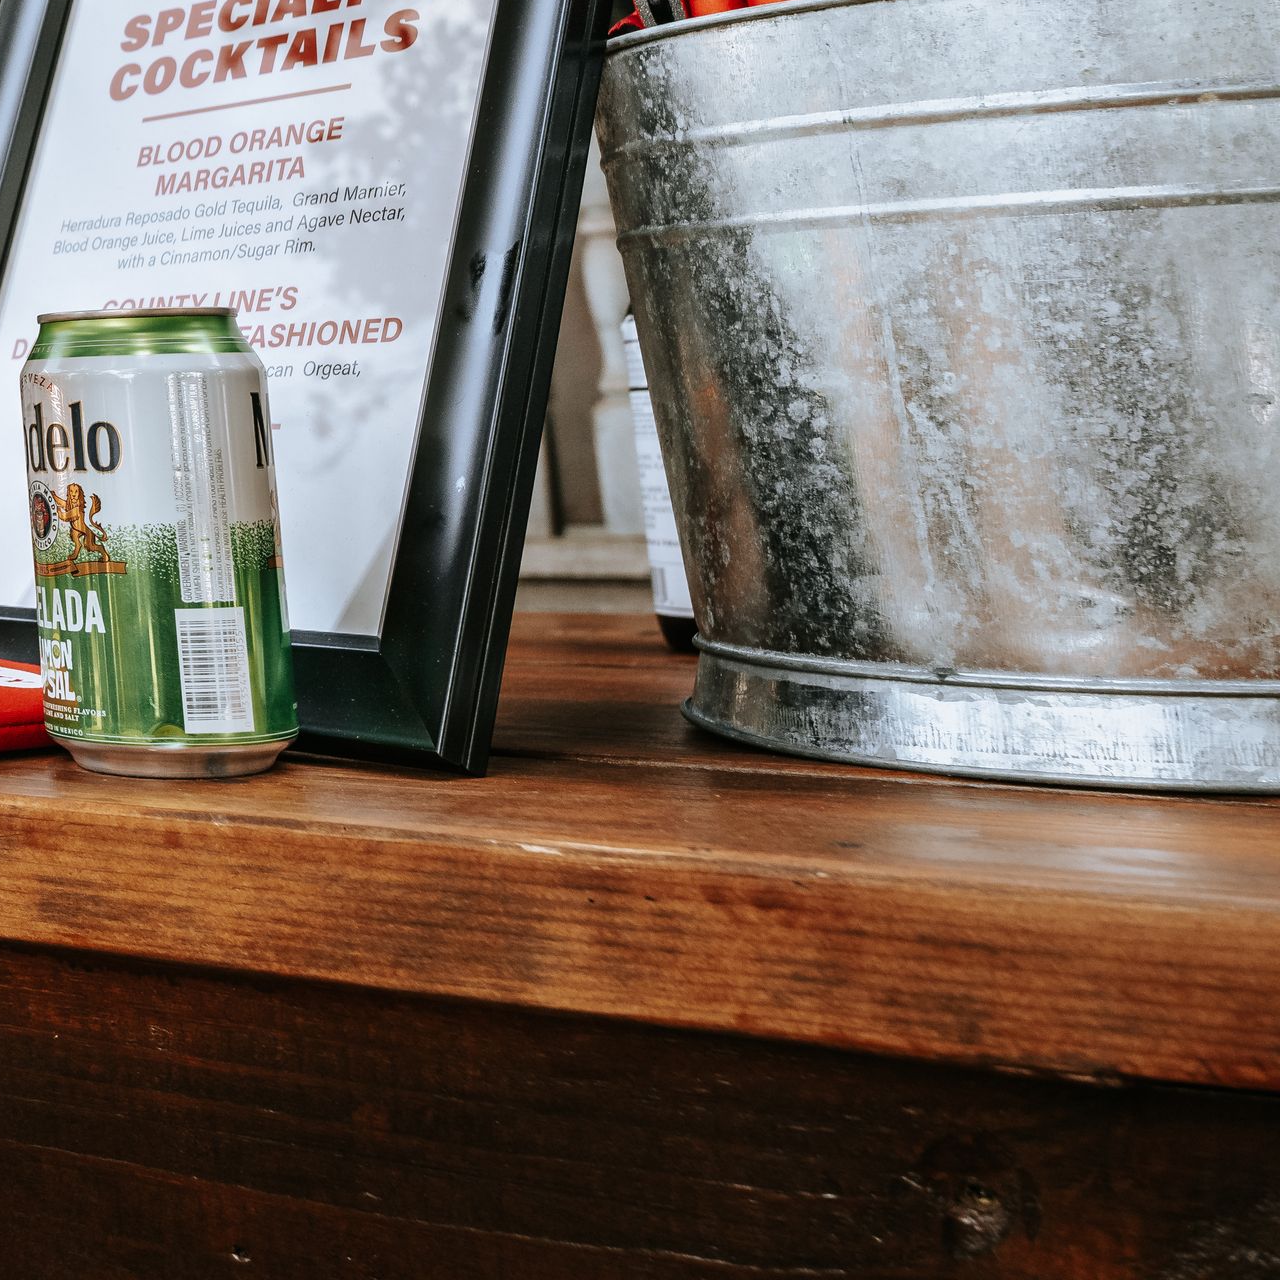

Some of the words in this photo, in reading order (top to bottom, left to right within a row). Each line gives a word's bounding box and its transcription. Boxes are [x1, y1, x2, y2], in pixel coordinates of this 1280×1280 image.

[109, 9, 420, 101] COCKTAILS
[137, 134, 222, 169] BLOOD
[230, 116, 345, 159] ORANGE
[155, 155, 305, 197] MARGARITA
[52, 239, 89, 255] Blood
[91, 235, 138, 251] Orange
[141, 231, 177, 247] Juice,
[181, 227, 214, 242] Lime
[218, 221, 261, 239] Juices
[265, 216, 293, 234] and
[296, 212, 345, 233] Agave
[349, 205, 406, 224] Nectar,
[60, 215, 122, 233] Herradura
[126, 205, 190, 228] Reposado
[194, 200, 226, 218] Gold
[231, 194, 283, 216] Tequila,
[292, 190, 339, 207] Grand
[343, 181, 407, 202] Marnier,
[117, 255, 144, 270] with
[147, 257, 156, 267] a
[160, 243, 280, 266] Cinnamon/Sugar
[284, 238, 316, 254] Rim.
[238, 317, 403, 349] FASHIONED
[266, 363, 294, 379] can
[303, 359, 362, 380] Orgeat,
[23, 400, 122, 473] delo
